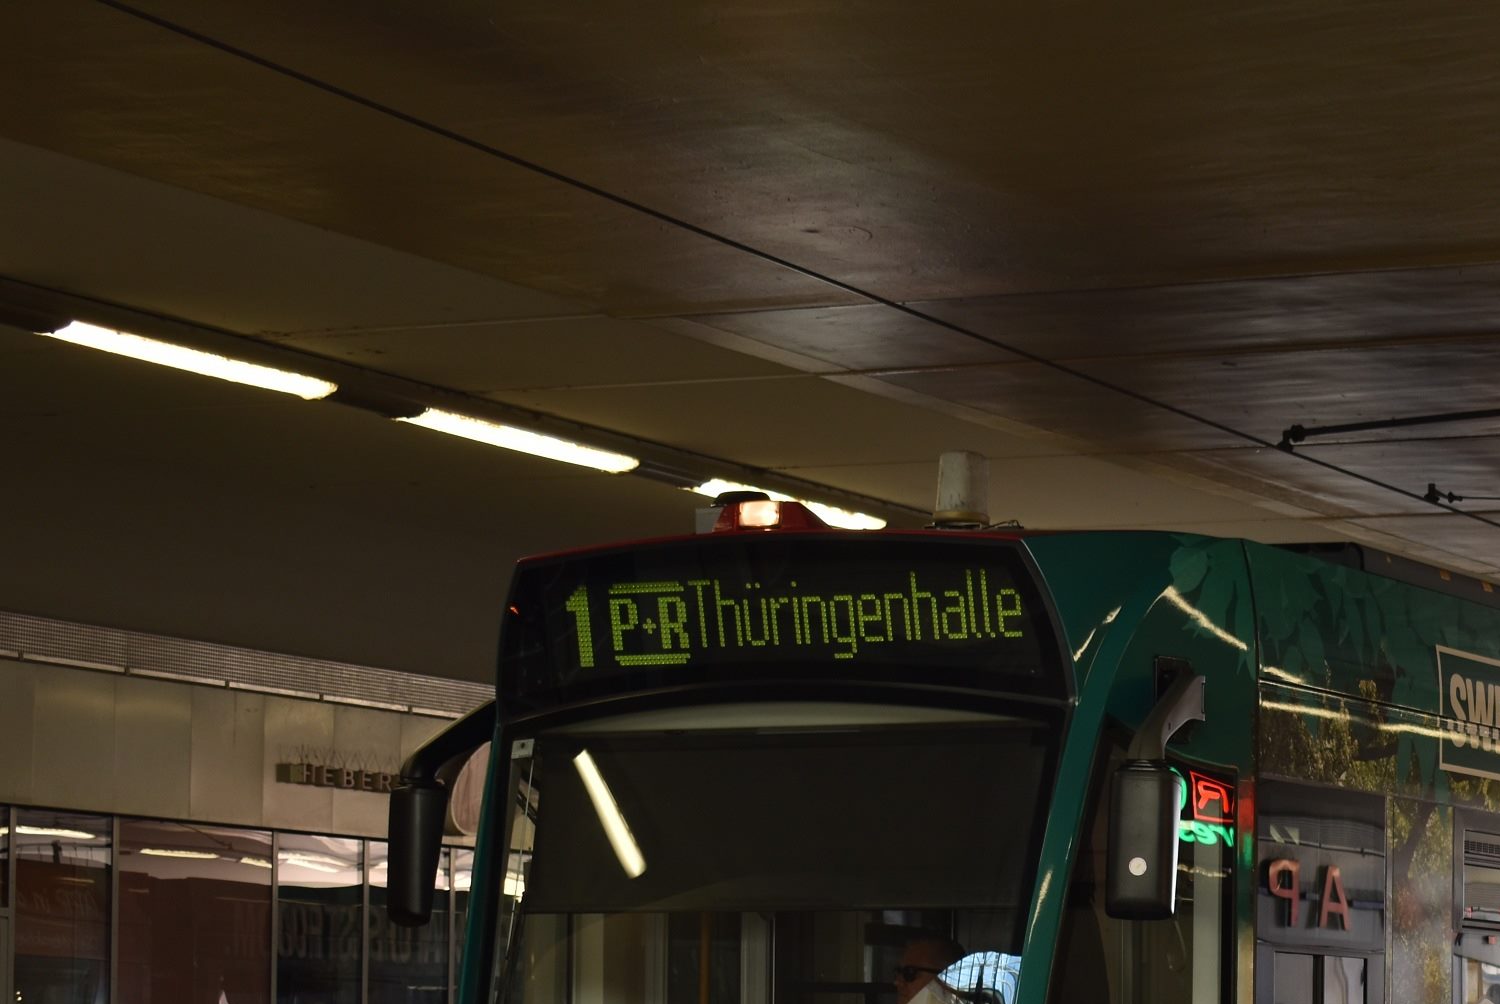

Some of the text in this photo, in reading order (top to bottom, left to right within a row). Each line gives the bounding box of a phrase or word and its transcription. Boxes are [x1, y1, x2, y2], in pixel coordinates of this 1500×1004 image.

[566, 568, 1024, 668] 1 P+R Thüringenhalle
